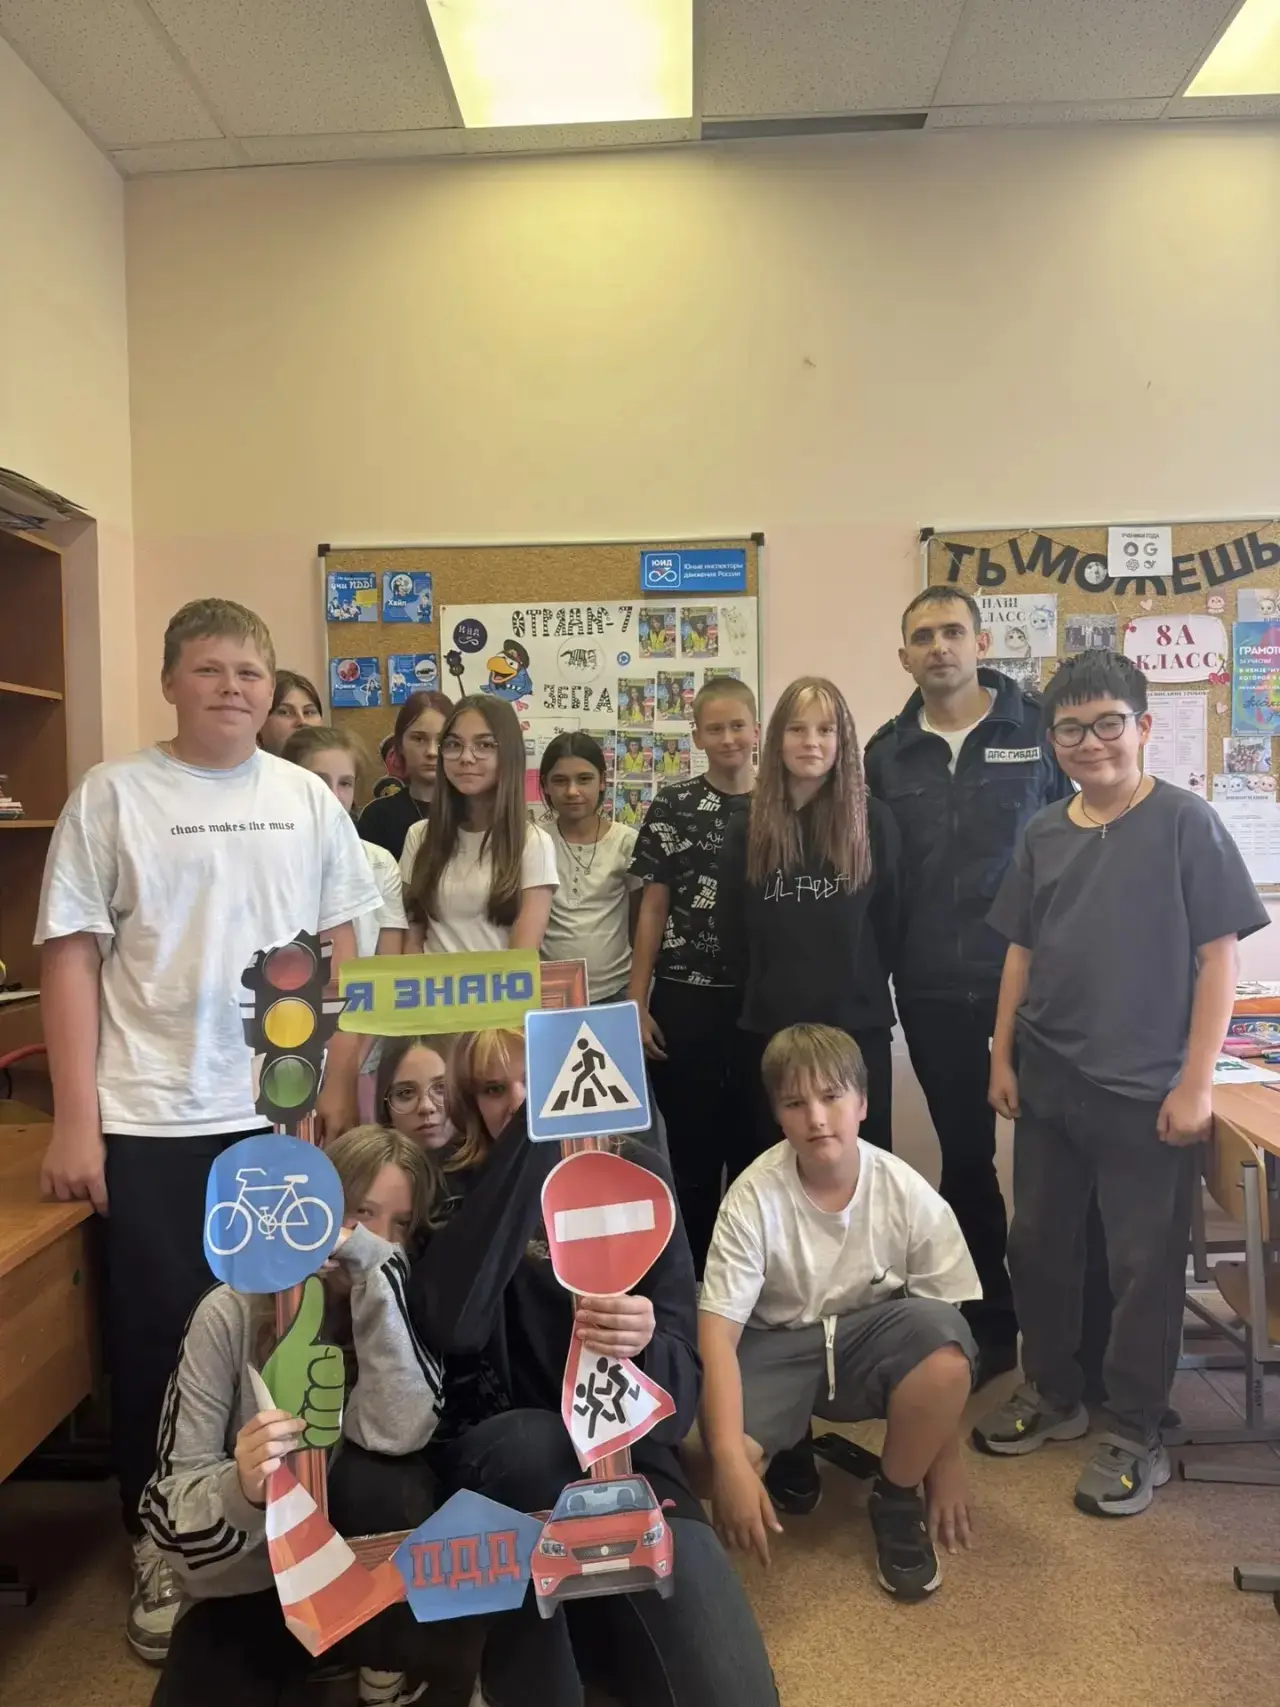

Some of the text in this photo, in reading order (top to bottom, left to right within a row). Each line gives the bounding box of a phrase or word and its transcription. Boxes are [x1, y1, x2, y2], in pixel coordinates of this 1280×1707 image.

[704, 563, 743, 571] инспекторы
[684, 571, 716, 579] движения
[1239, 646, 1280, 655] ГРАМОТ
[1136, 652, 1217, 670] КЛАСС
[988, 748, 1039, 759] ДПС ГИБДД
[170, 820, 295, 836] chaos makes the muse
[343, 971, 534, 1013] Я ЗНАЮ
[409, 1528, 520, 1591] ПДД
